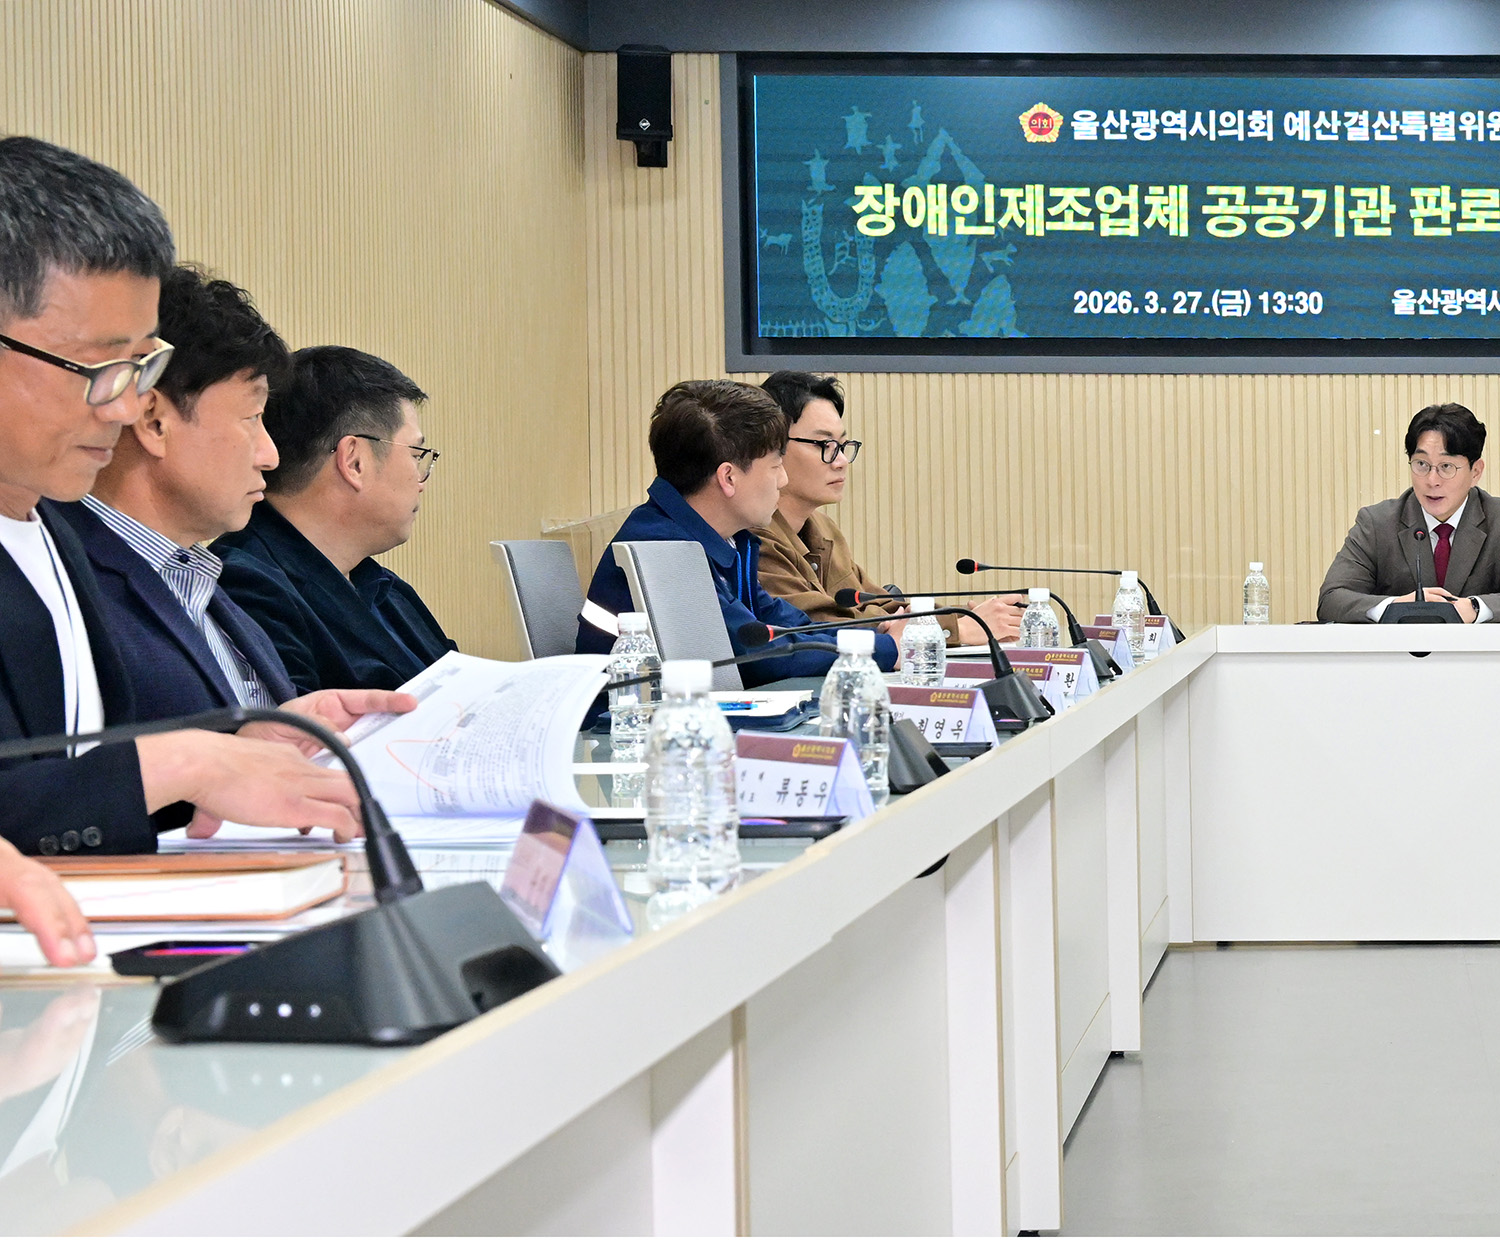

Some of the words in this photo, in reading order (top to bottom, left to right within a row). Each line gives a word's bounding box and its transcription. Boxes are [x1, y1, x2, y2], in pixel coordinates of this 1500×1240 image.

[1030, 117, 1052, 129] 의회
[1070, 109, 1274, 142] 울산광역시의회
[852, 184, 1190, 238] 장애인제조업체
[1201, 184, 1396, 238] 공공기관
[1073, 290, 1139, 314] 2026.
[1144, 290, 1167, 314] 3.
[1172, 289, 1252, 317] 27.(금)
[1258, 290, 1324, 315] 13:30
